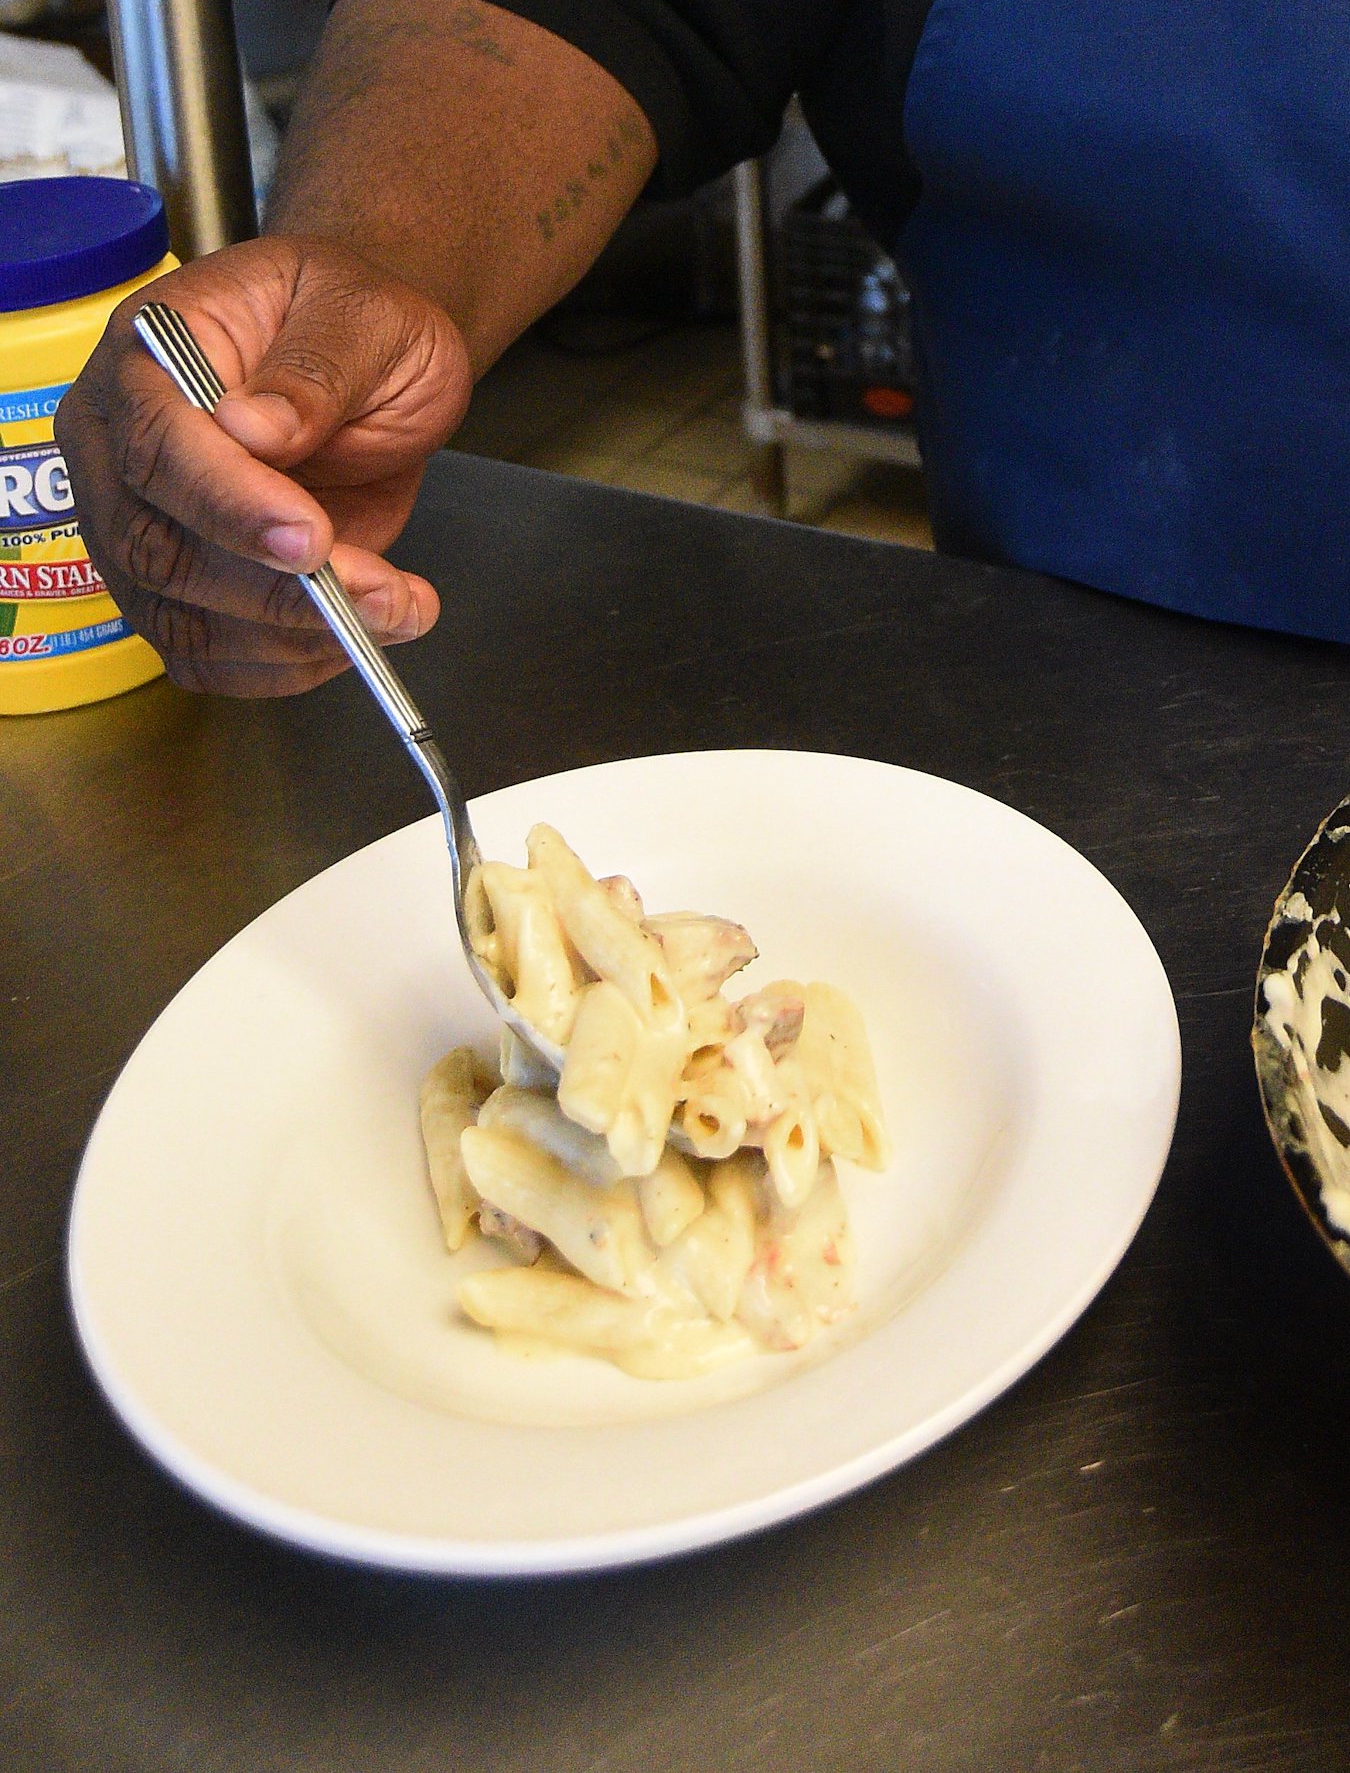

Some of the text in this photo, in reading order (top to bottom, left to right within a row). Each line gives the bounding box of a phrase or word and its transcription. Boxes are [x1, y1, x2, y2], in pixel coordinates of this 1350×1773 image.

[2, 526, 79, 547] 100% PU
[96, 619, 124, 638] GRAMS
